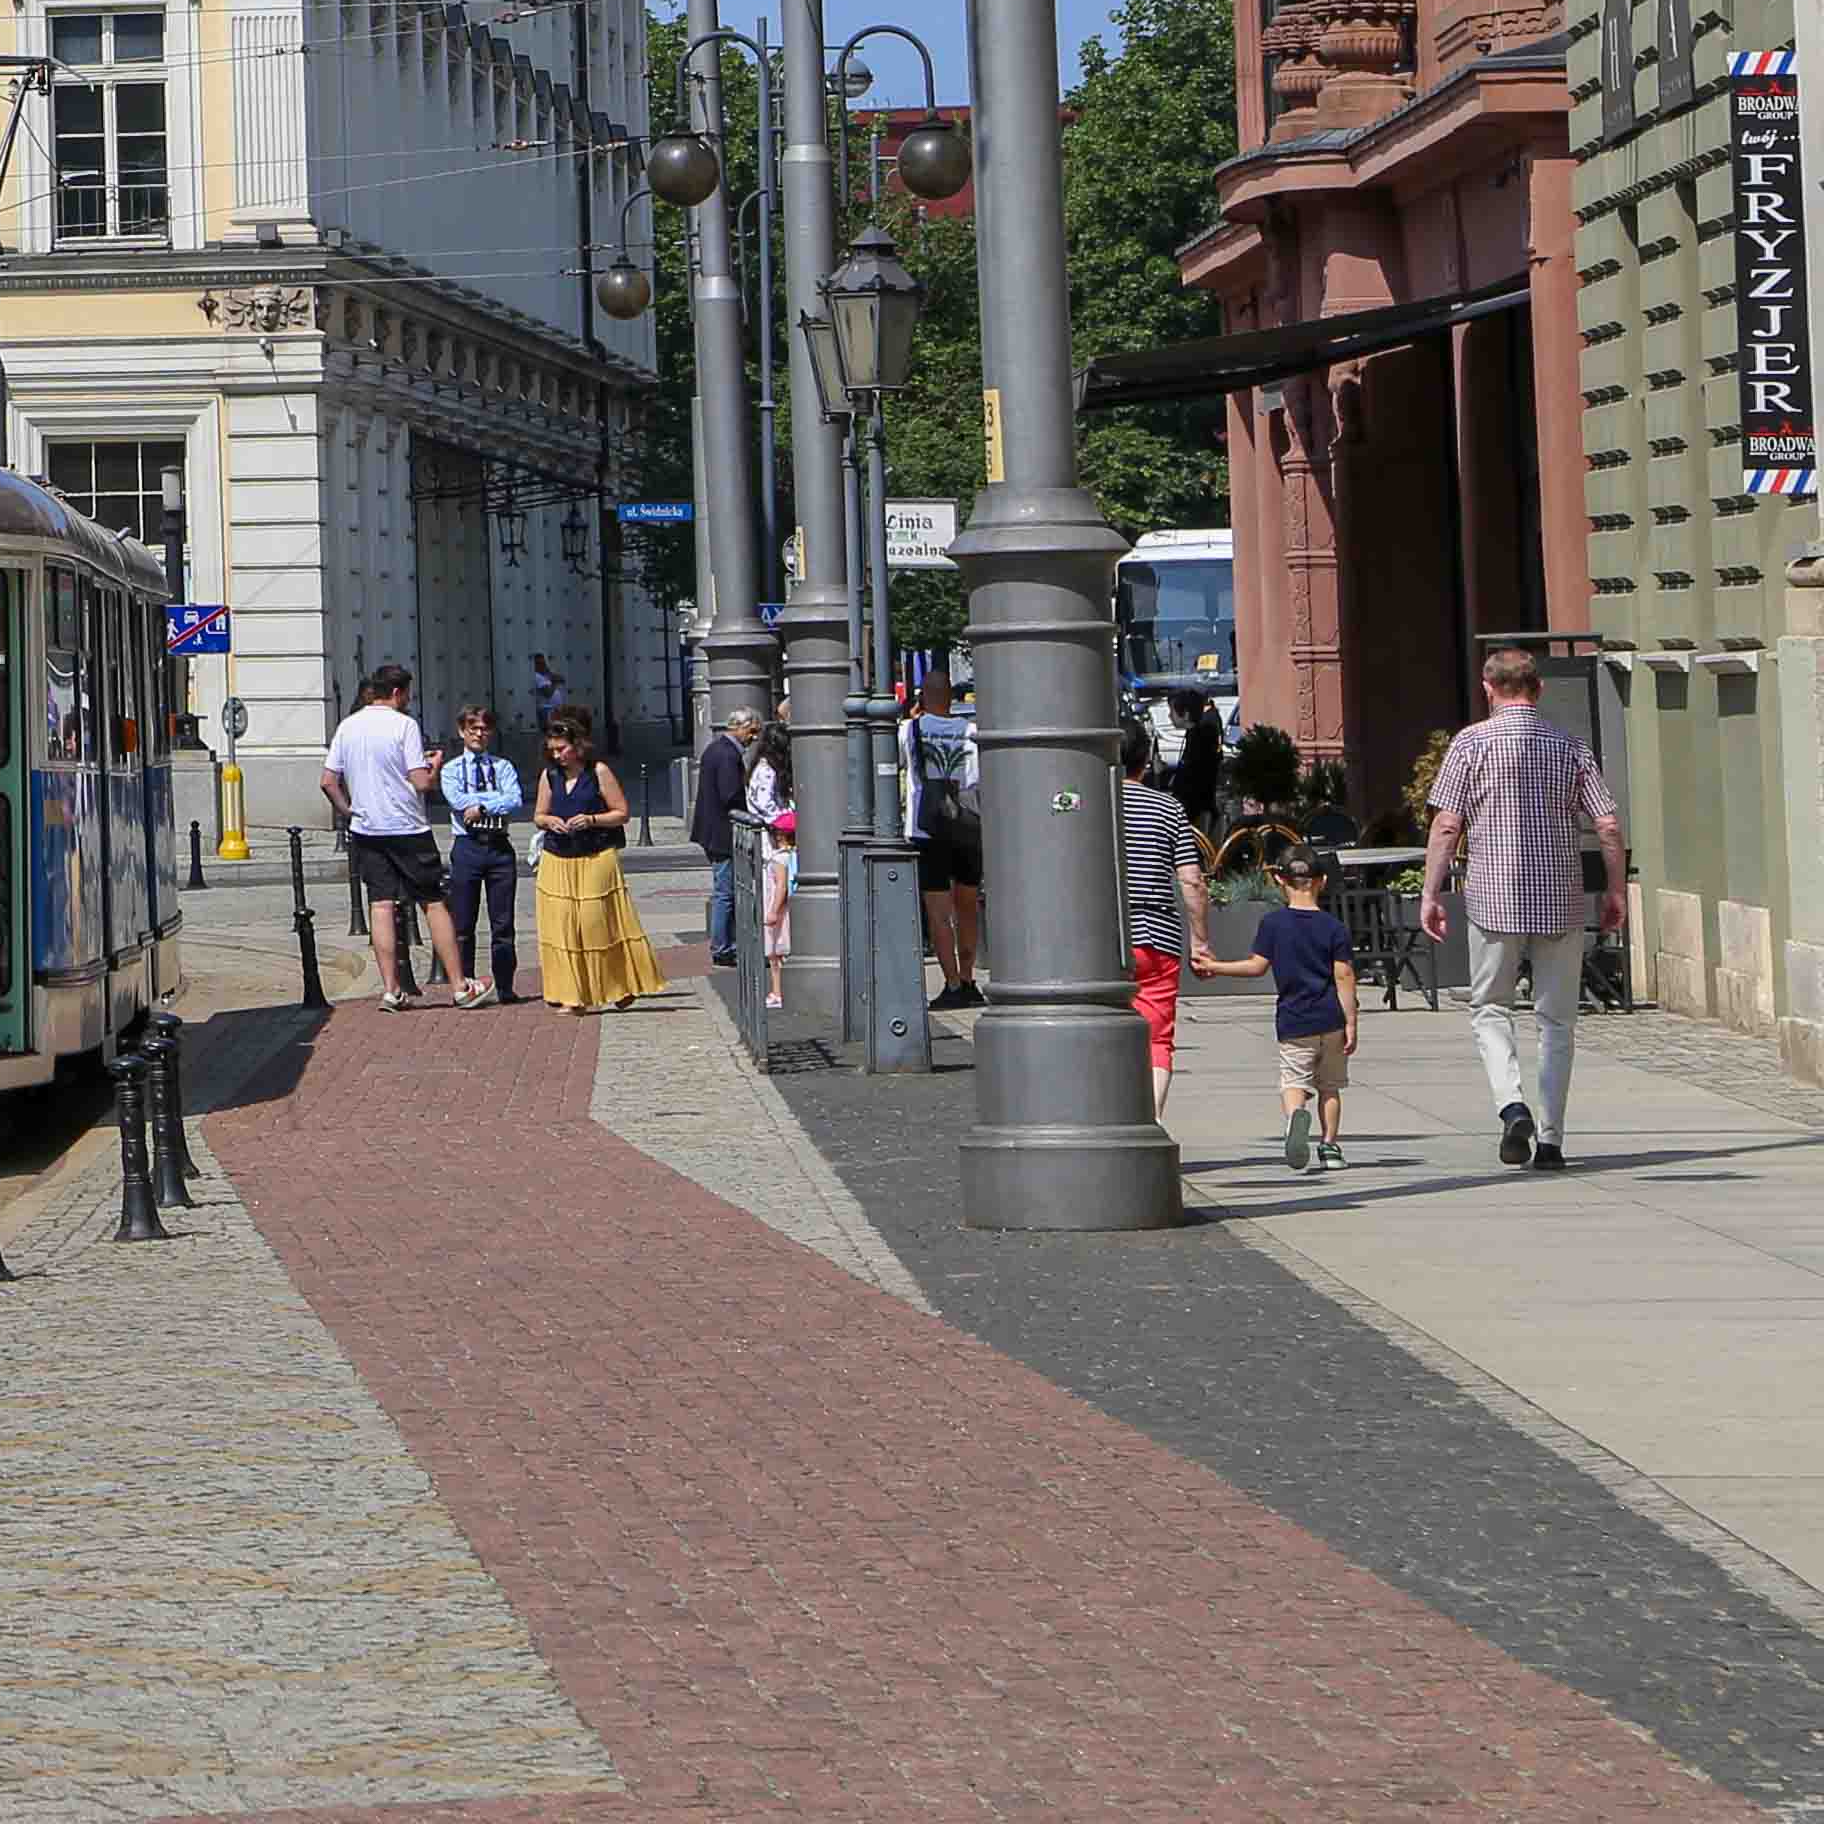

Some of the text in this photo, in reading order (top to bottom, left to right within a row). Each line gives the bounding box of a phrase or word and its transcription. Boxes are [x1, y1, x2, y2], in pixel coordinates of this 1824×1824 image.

[1737, 95, 1800, 111] BROADW
[1757, 111, 1793, 120] GROUP
[1741, 129, 1778, 149] twój
[1741, 154, 1803, 413] FRYZJER
[1749, 436, 1816, 452] BROADWA
[1769, 451, 1806, 461] GROUP
[887, 512, 934, 529] Linia
[888, 543, 945, 556] uzealna
